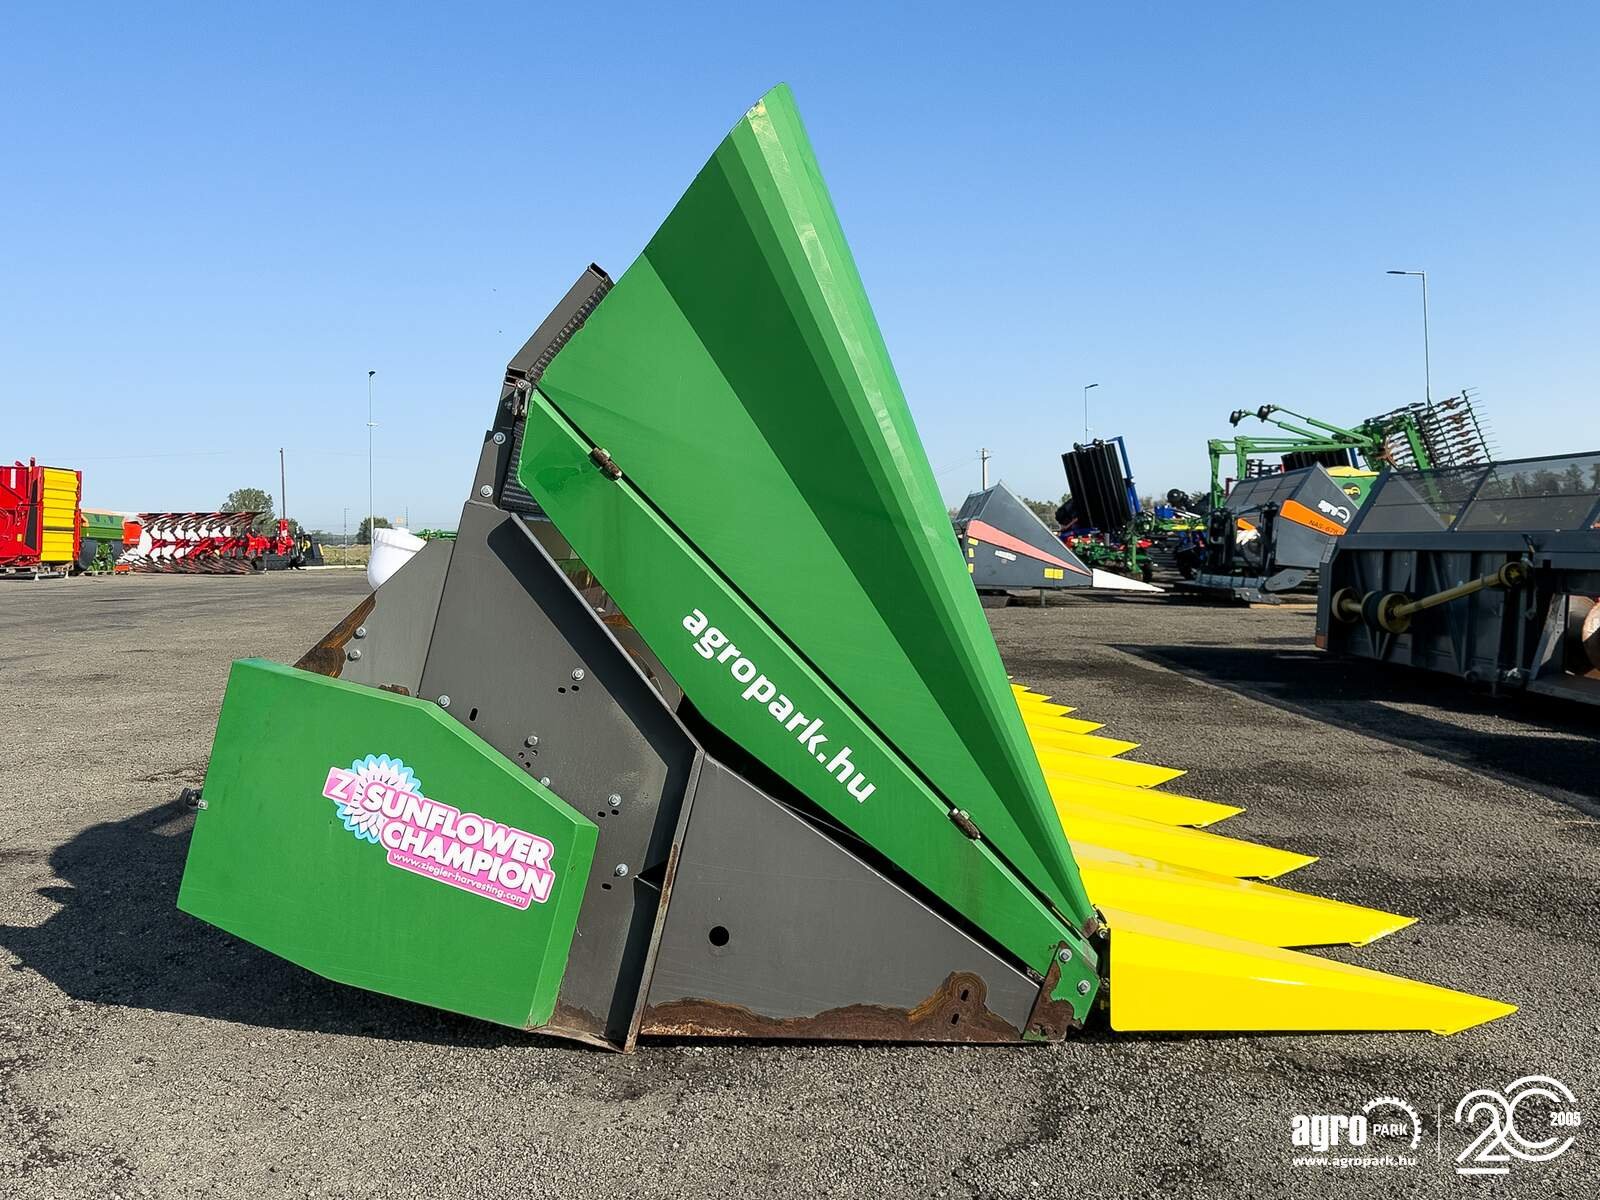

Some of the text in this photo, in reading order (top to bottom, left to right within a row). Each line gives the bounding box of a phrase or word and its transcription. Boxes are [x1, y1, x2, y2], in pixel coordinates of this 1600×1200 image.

[682, 608, 877, 804] agropark.hu
[362, 784, 550, 870] SUNFLOWER
[382, 821, 551, 899] CHAMPION
[392, 852, 526, 904] www.ziegler-harvesting.com
